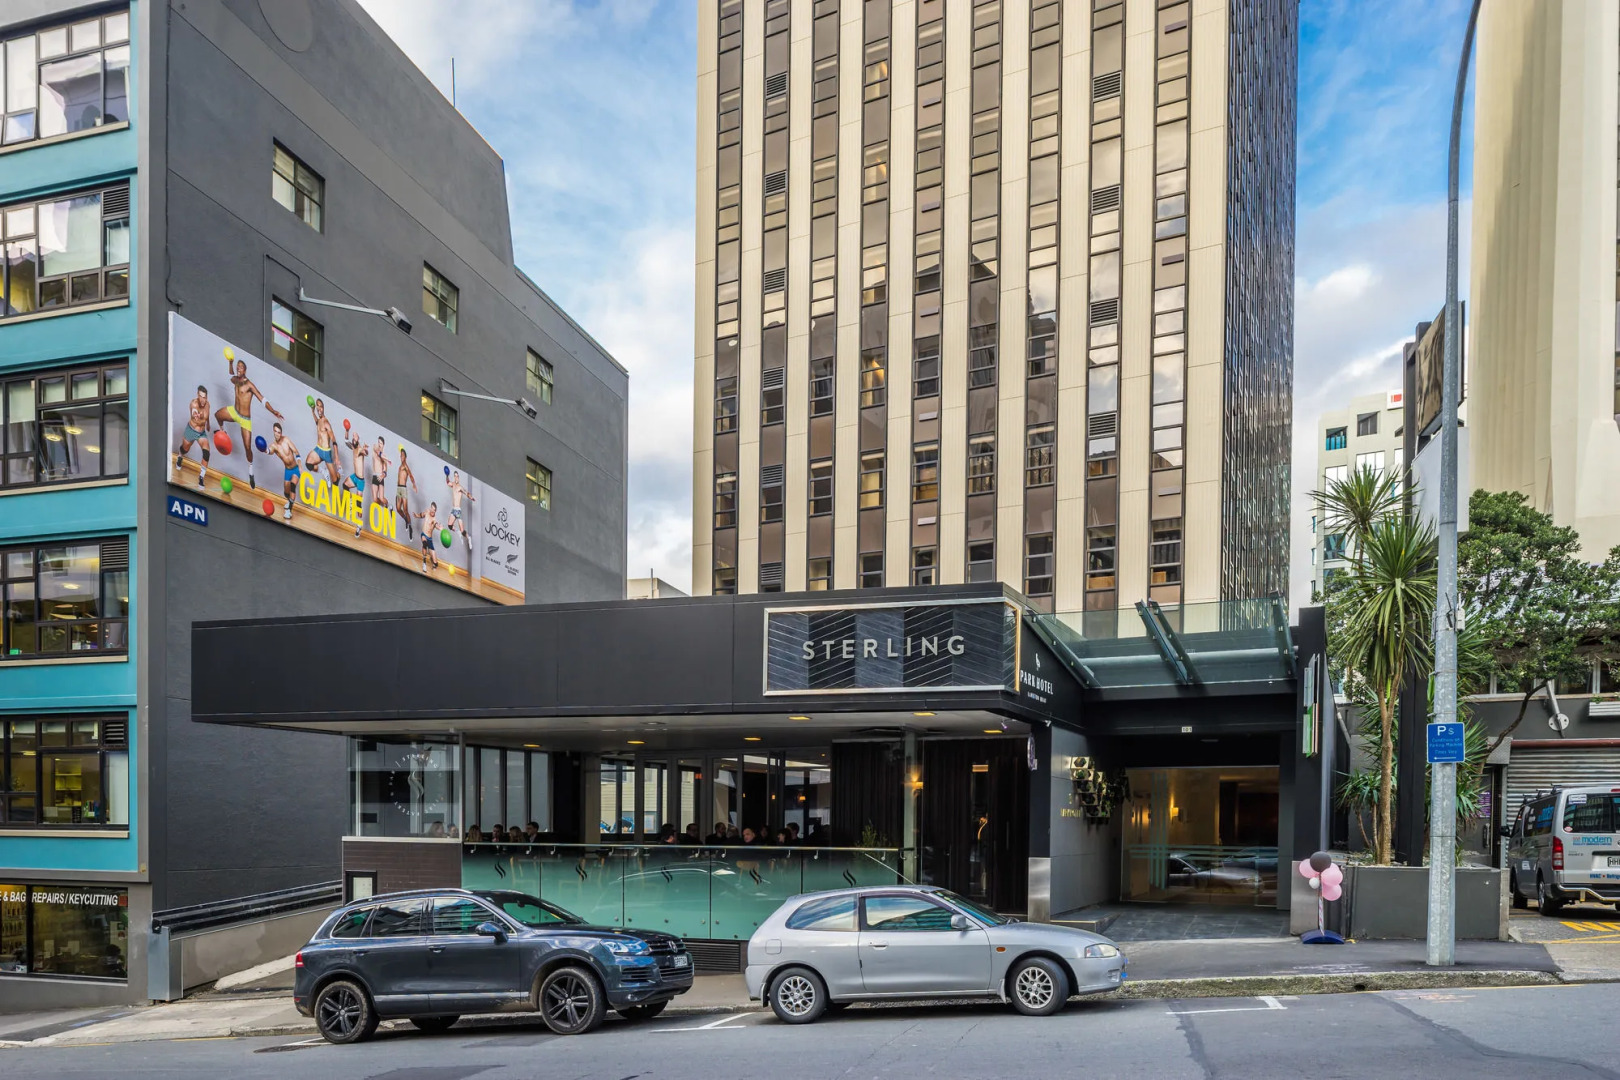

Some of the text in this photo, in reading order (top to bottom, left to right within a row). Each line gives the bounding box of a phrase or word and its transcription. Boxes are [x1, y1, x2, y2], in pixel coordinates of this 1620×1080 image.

[170, 500, 206, 523] APN
[299, 470, 396, 540] GAME ON
[485, 522, 520, 547] JOCKEY
[802, 635, 965, 660] STERLING
[1020, 669, 1054, 695] PARK HOTEL
[1437, 725, 1447, 736] P
[1581, 835, 1612, 844] modern
[3, 892, 8, 902] &
[10, 891, 26, 902] BAG
